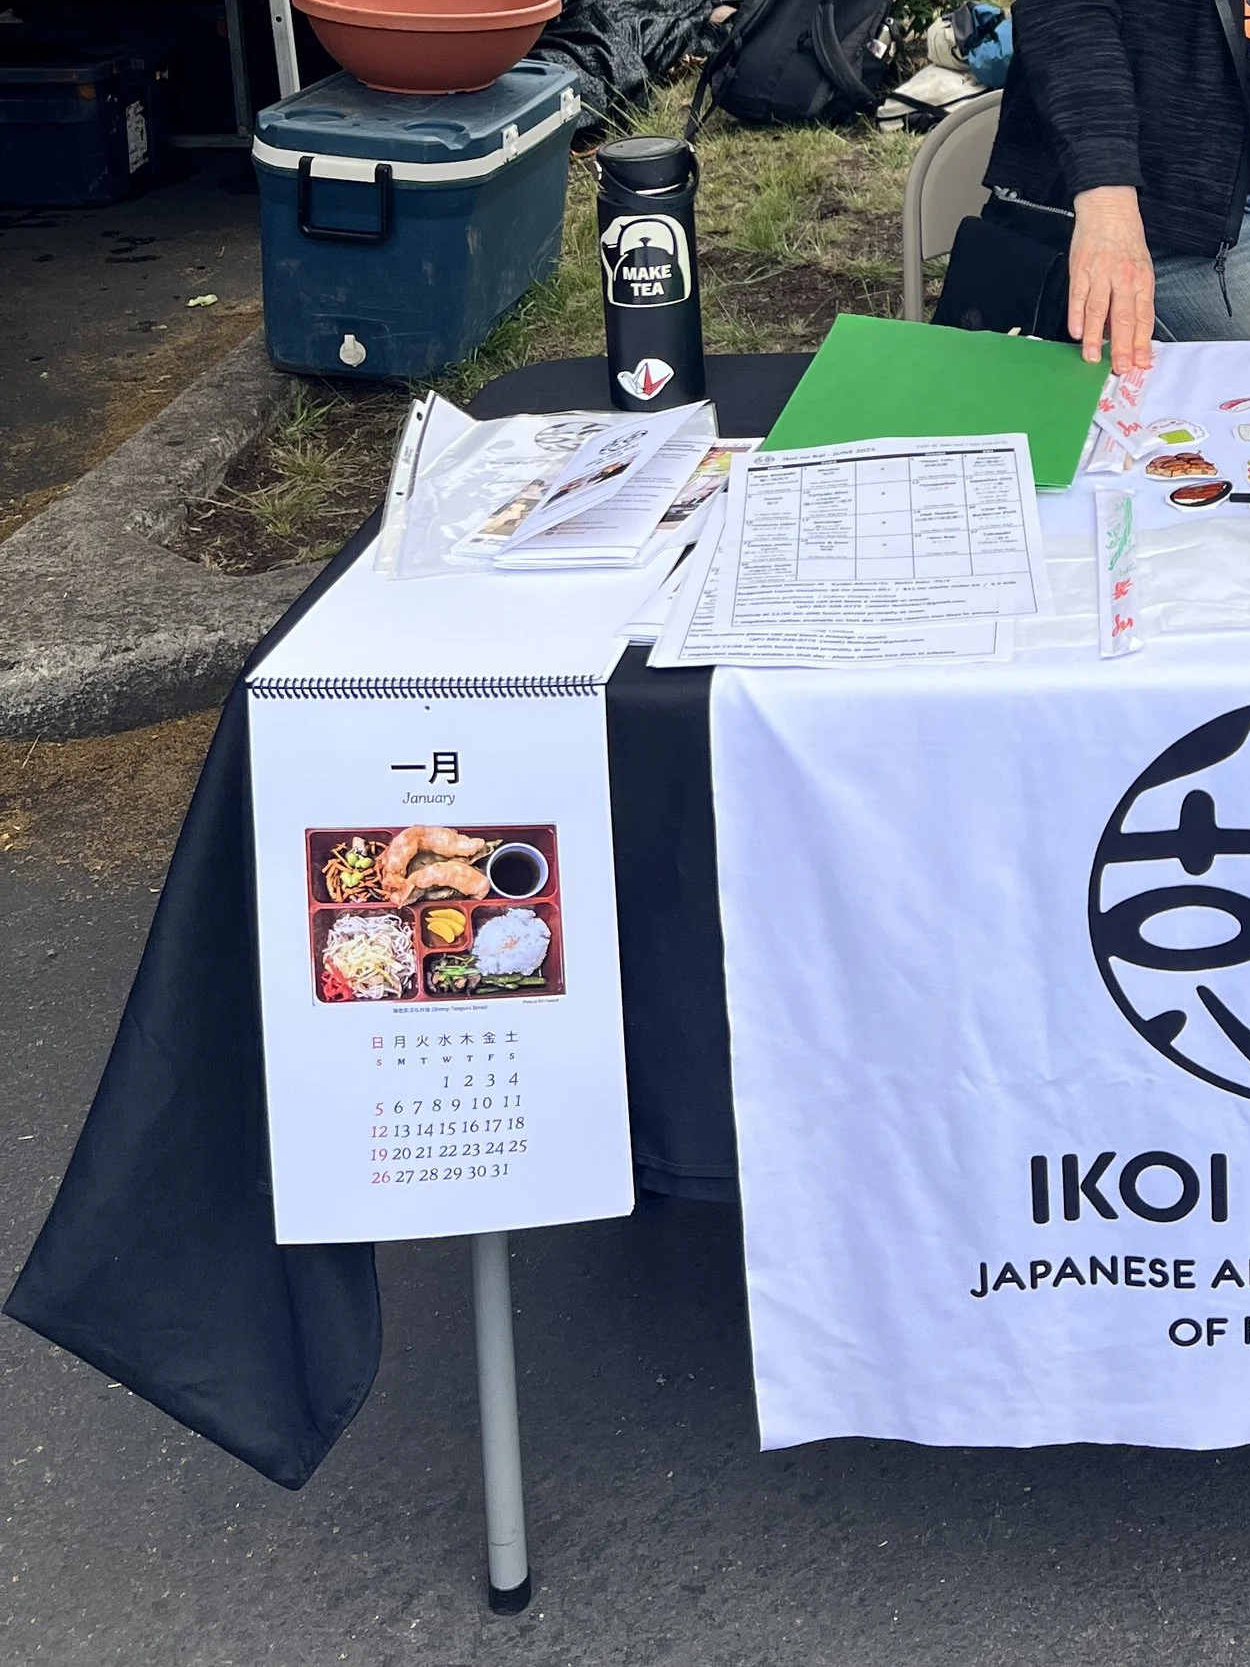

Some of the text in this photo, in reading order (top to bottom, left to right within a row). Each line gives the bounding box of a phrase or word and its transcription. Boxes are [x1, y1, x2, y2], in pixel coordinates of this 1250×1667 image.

[622, 264, 672, 281] MAKE
[630, 282, 665, 297] TEA
[390, 751, 459, 784] 一月
[402, 792, 456, 806] January
[372, 1030, 519, 1049] 日 月 火 水 木 金 土
[420, 1057, 427, 1065] T
[509, 1052, 515, 1060] S
[443, 1072, 518, 1088] 1 2 3 4
[375, 1095, 521, 1116] 5 6 7 8 9 10 11
[371, 1116, 525, 1138] 12 13 14 15 16 17 18
[371, 1139, 528, 1162] 19 20 21 22 23 24 25
[371, 1163, 509, 1184] 26 27 28 29 30 31
[1030, 1151, 1228, 1224] IKOI
[970, 1255, 1196, 1297] JAPANESE
[1168, 1318, 1228, 1347] OF
